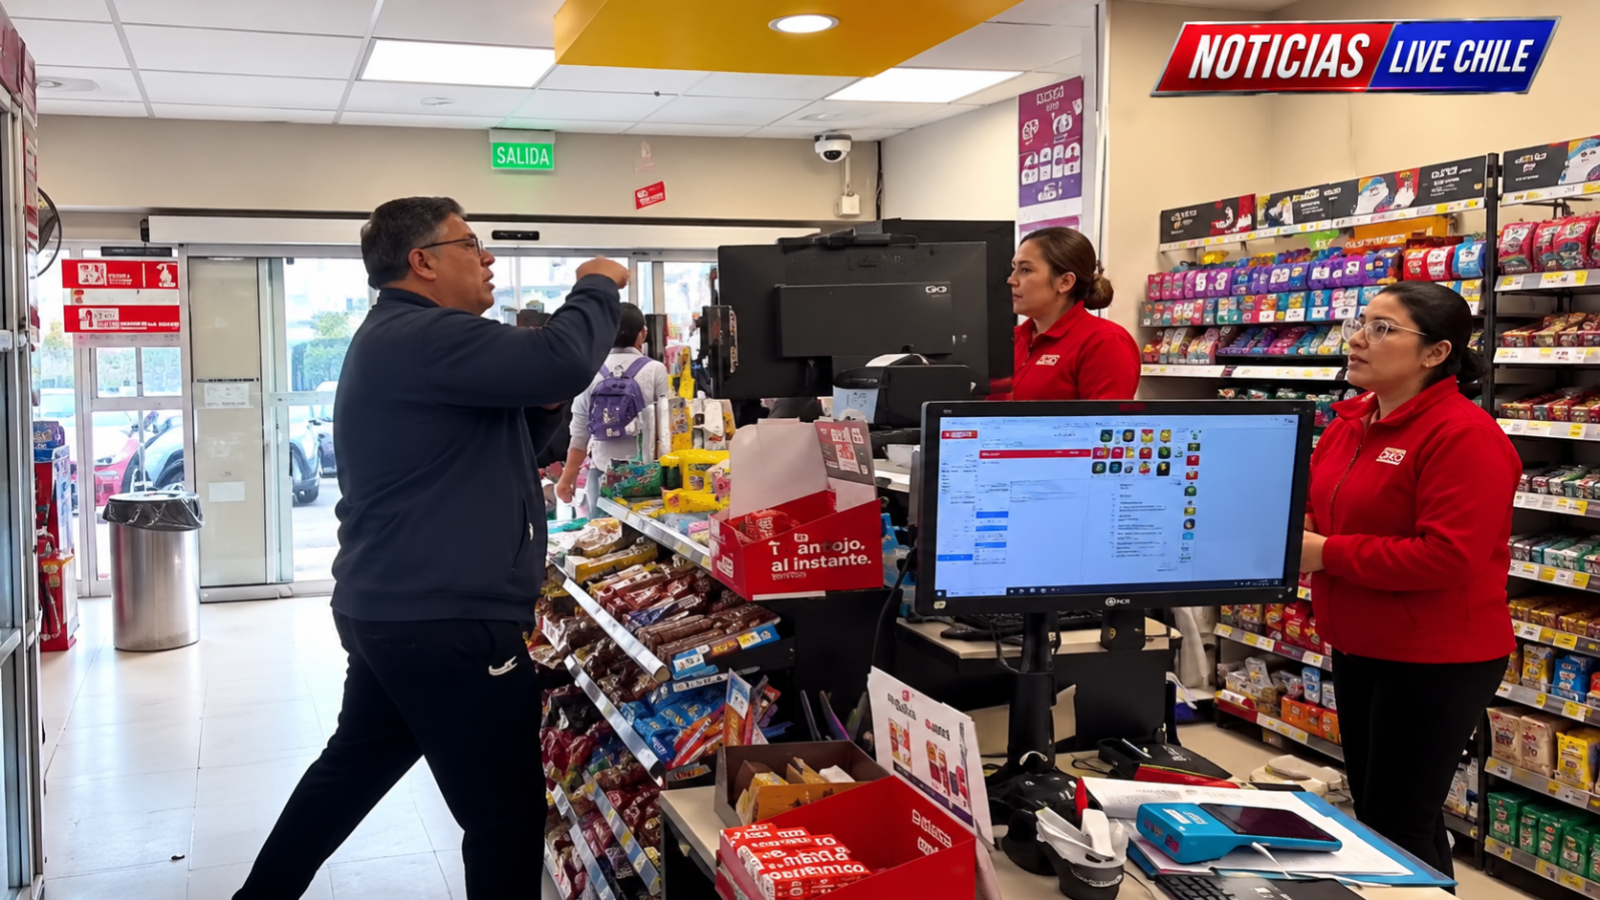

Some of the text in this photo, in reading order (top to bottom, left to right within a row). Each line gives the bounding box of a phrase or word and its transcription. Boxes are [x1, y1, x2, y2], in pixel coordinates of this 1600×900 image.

[497, 146, 550, 166] SALIDA
[771, 553, 872, 572] al instante.
